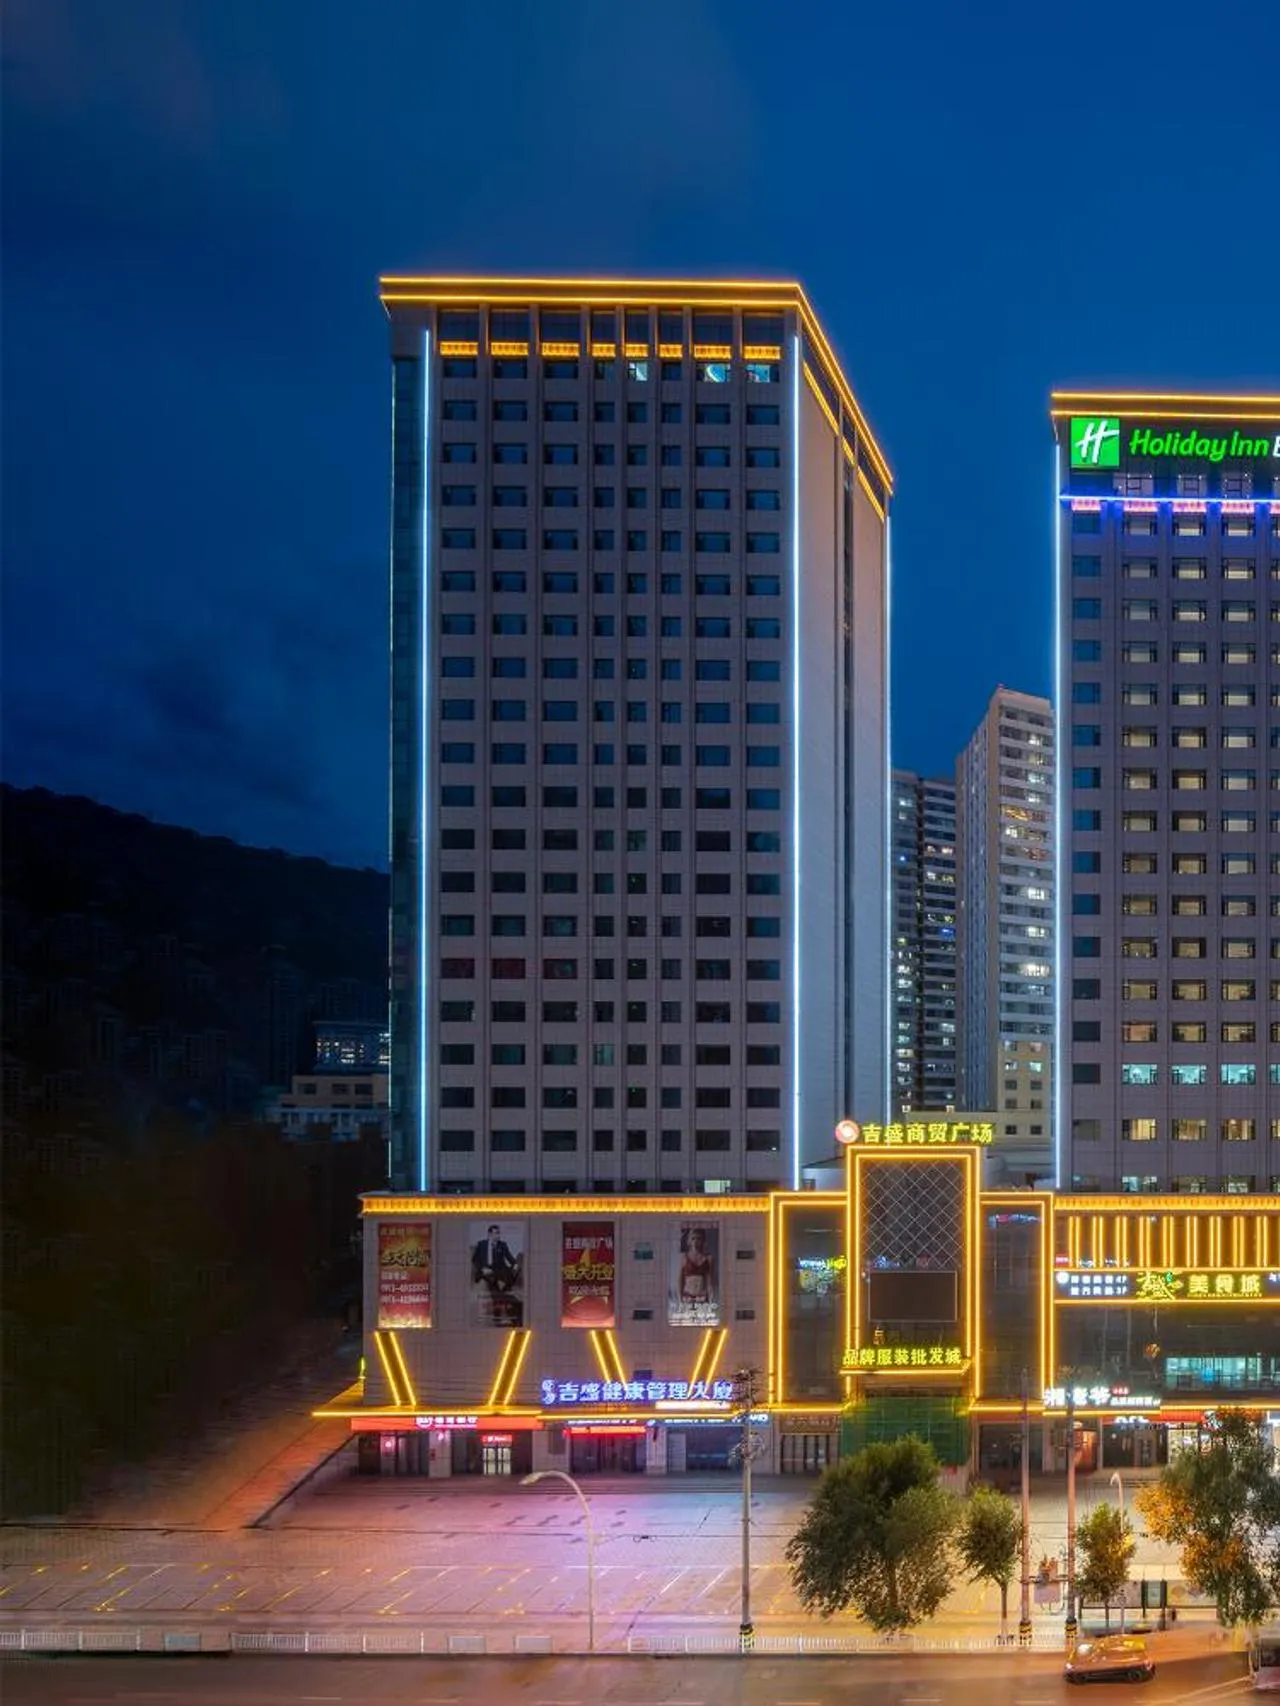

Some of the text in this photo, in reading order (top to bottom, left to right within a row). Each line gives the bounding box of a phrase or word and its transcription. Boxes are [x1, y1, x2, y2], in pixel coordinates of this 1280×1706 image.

[1129, 429, 1228, 462] Holiday
[1231, 431, 1270, 457] Inn
[862, 1122, 993, 1143] 吉盛商贸广场
[842, 1347, 962, 1366] 品牌服装批发城
[559, 1381, 733, 1401] 吉盛健康管理大厦
